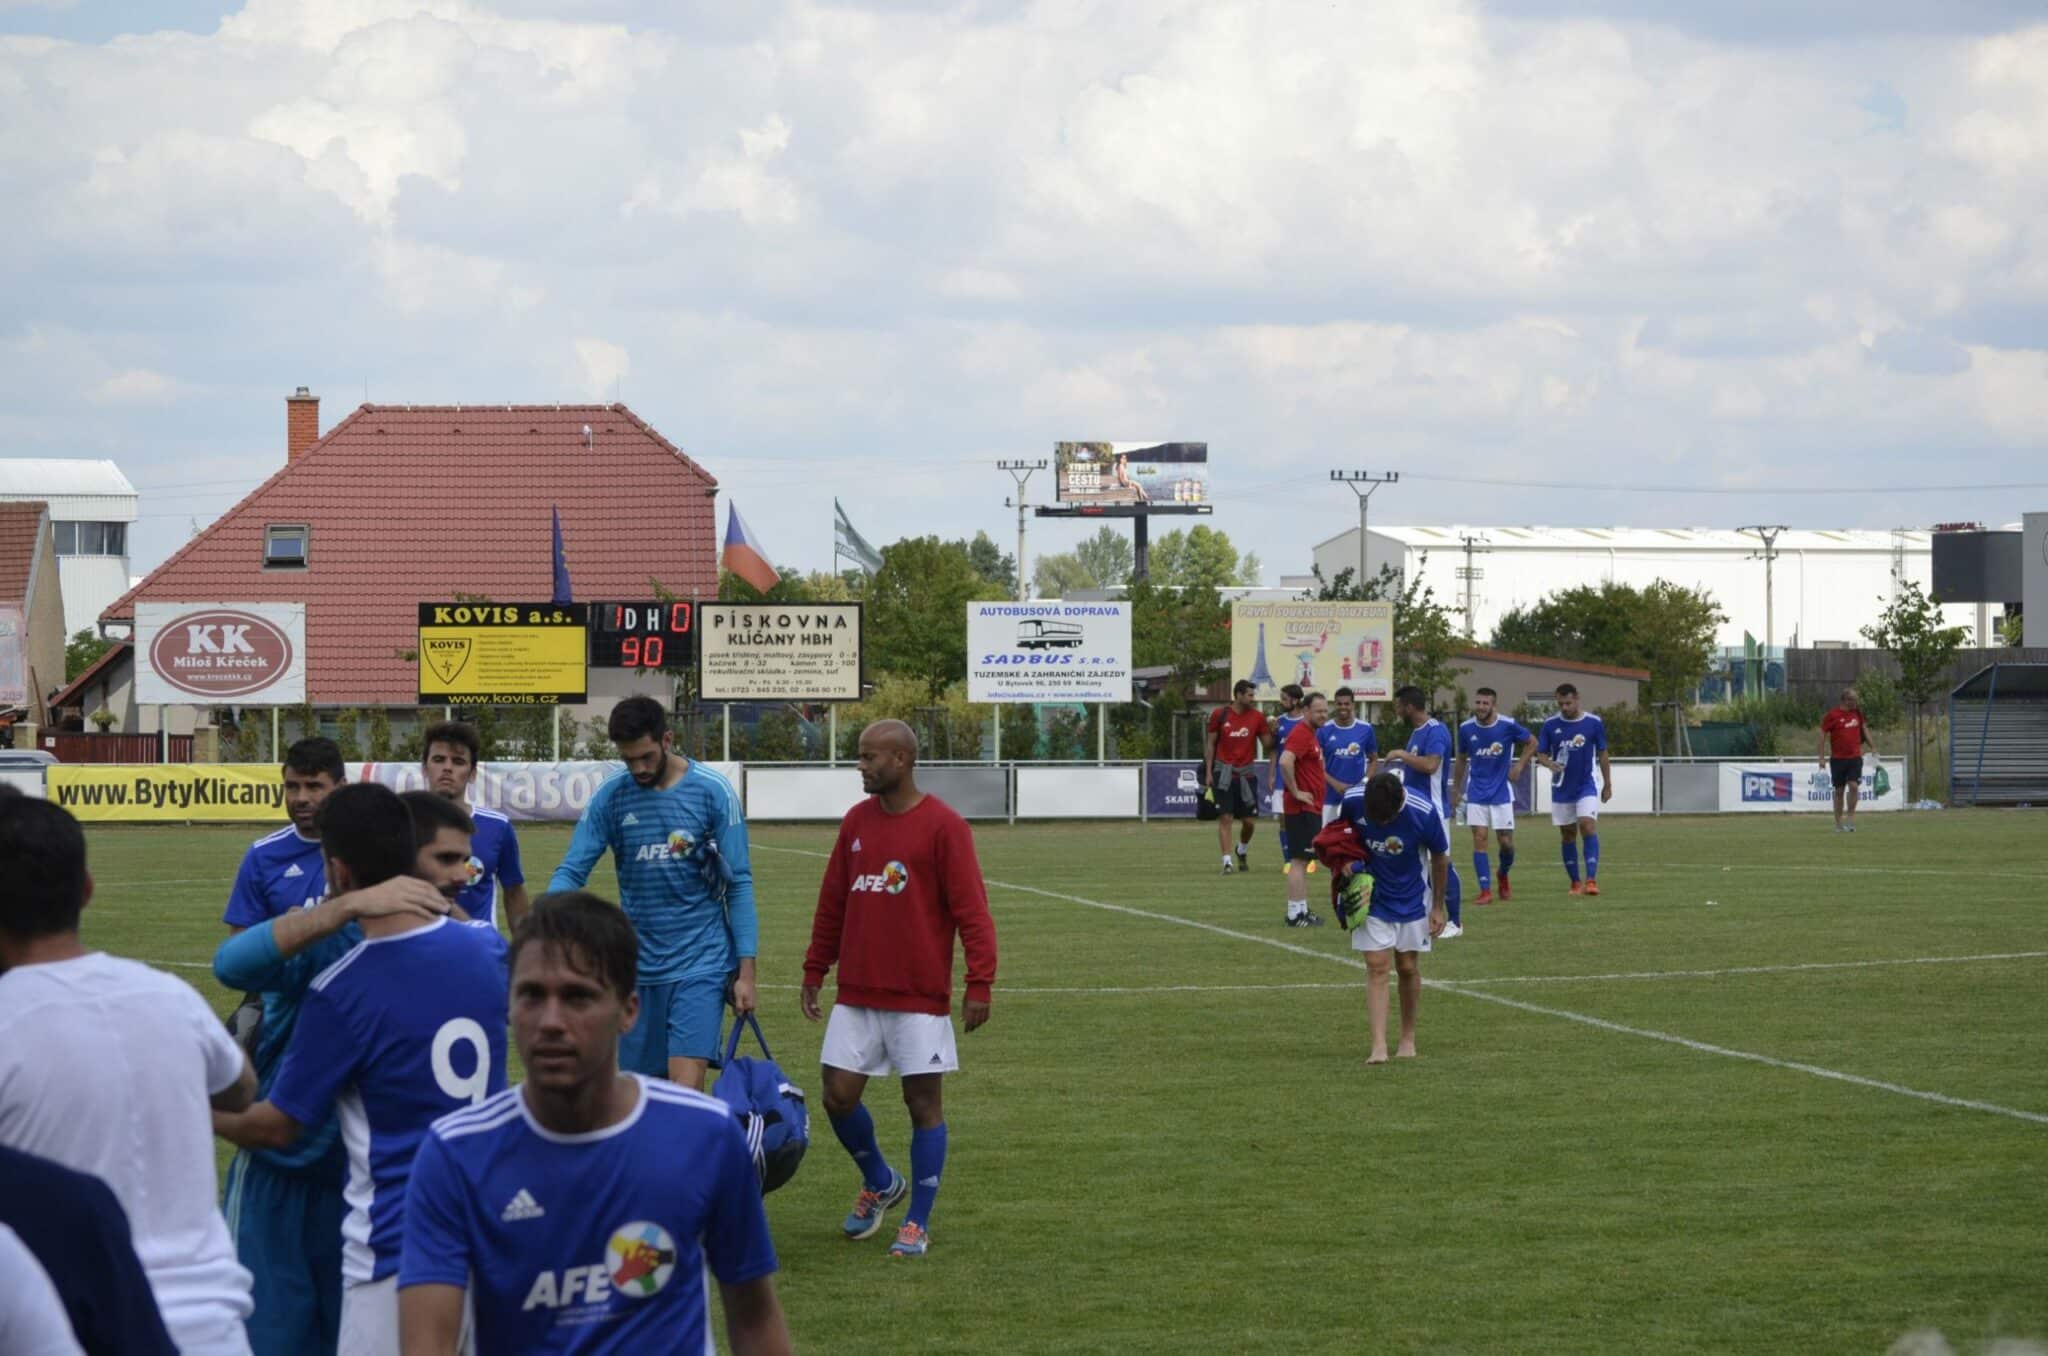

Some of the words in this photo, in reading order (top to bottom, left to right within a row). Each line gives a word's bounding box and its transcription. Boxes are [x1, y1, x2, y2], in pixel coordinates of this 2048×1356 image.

[434, 607, 519, 624] KOVIS
[529, 610, 572, 624] a.s.
[625, 608, 637, 630] D
[647, 608, 659, 631] H
[671, 602, 691, 632] 0
[713, 610, 847, 628] PÍSKOVNA
[980, 605, 1061, 617] AUTOBUSOVÁ
[1064, 607, 1120, 617] DOPRAVA
[187, 624, 255, 653] KK
[430, 640, 466, 649] KOVIS
[801, 633, 833, 646] HBH
[622, 636, 663, 667] 90
[981, 654, 1073, 665] SADBUS
[174, 655, 212, 668] Miloš
[216, 655, 268, 668] Křeček
[1023, 671, 1029, 679] A
[448, 693, 560, 704] www.kovis.cz
[635, 843, 670, 861] AFE
[851, 874, 885, 893] AFE
[430, 1016, 491, 1106] 9
[522, 1263, 612, 1311] AFE
